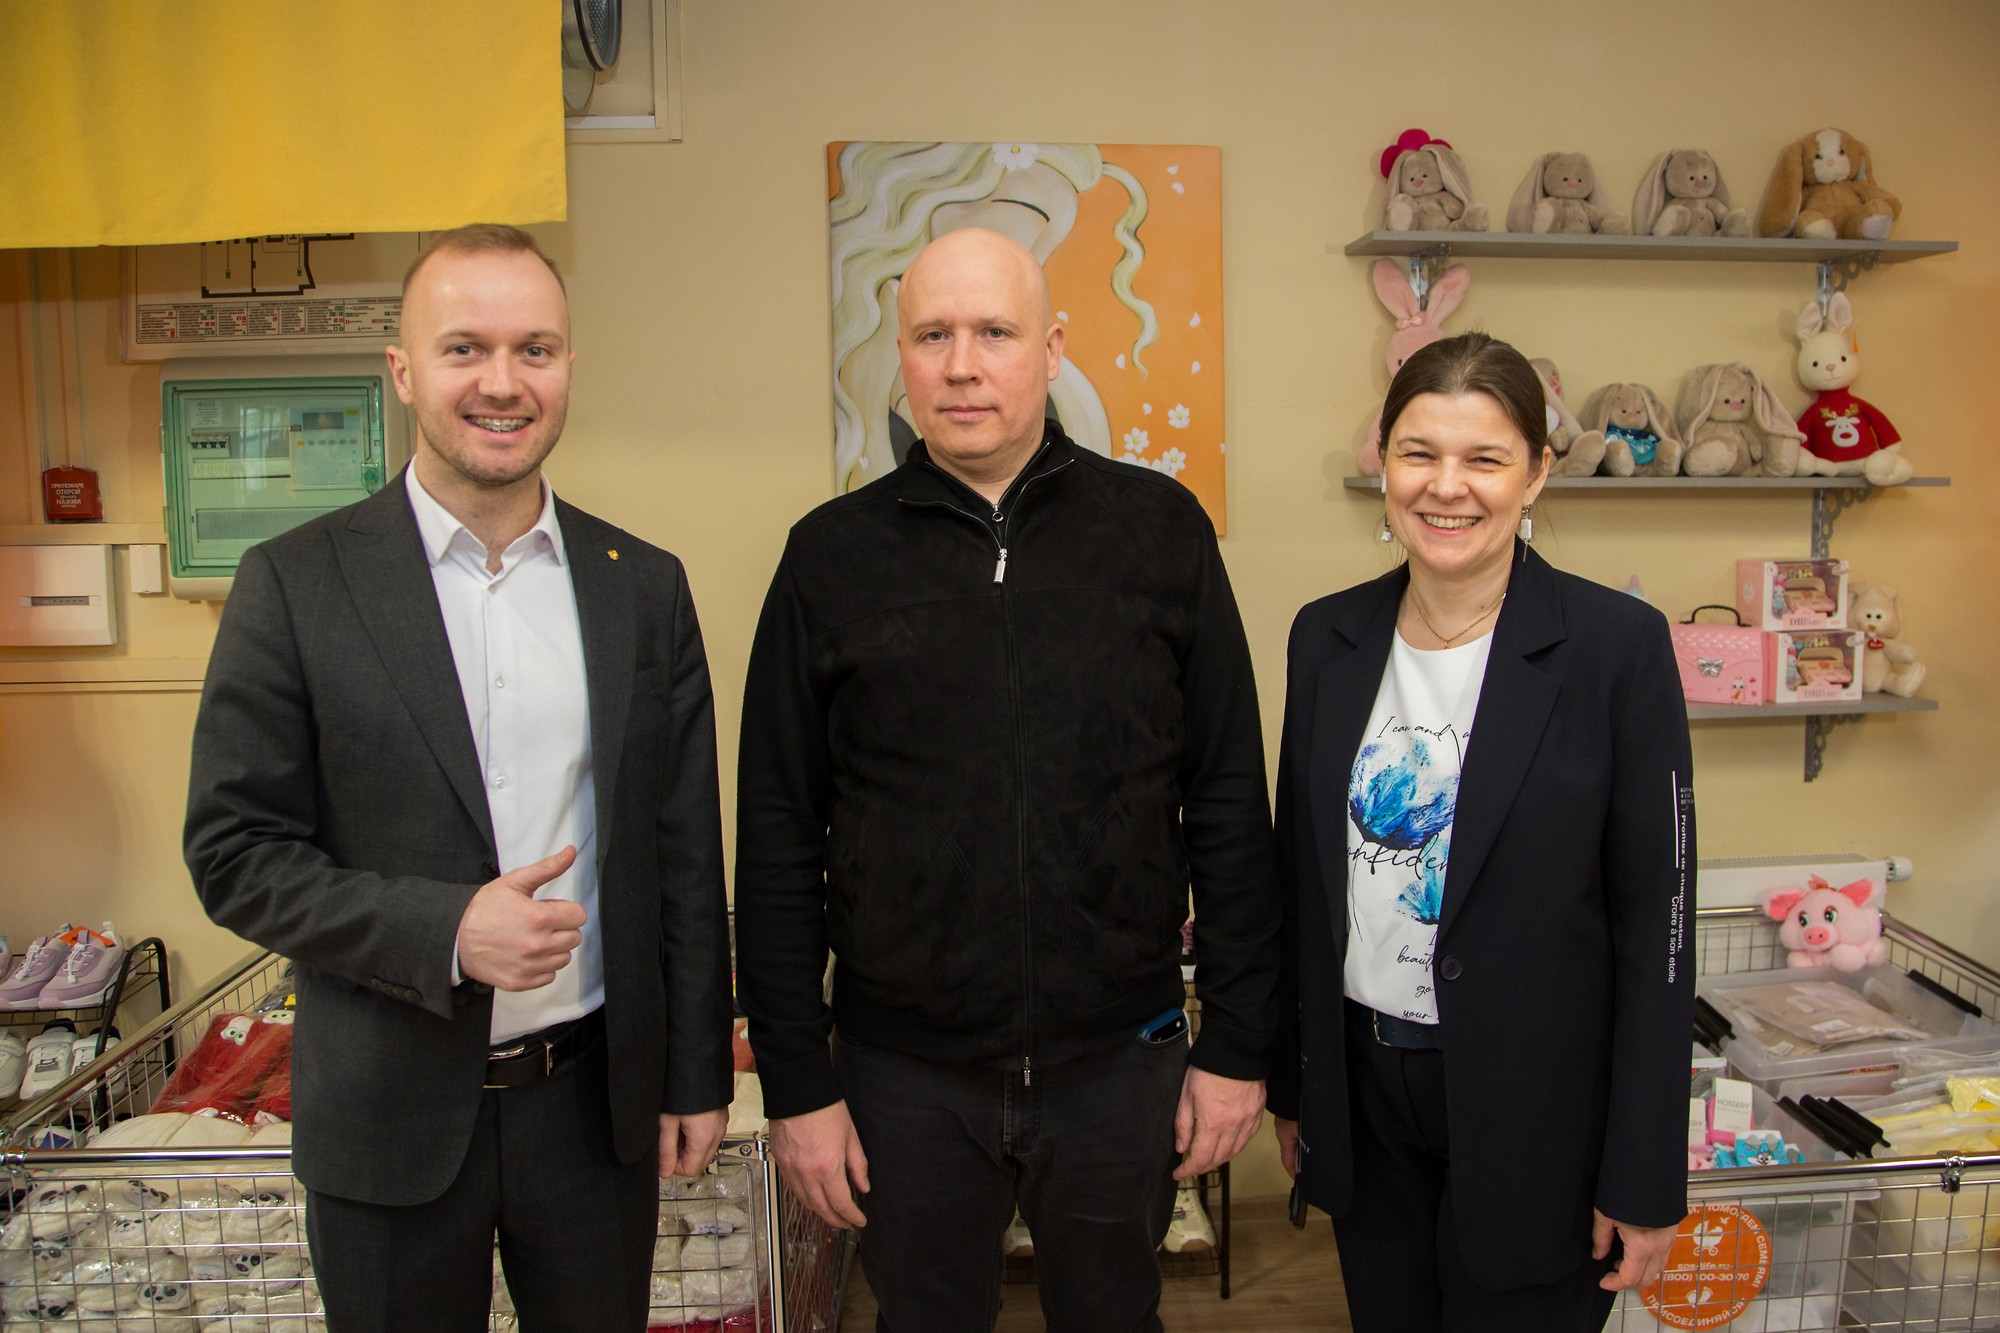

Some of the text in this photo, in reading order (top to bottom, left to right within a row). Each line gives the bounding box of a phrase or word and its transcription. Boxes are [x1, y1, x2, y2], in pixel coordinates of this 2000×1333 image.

[1414, 723, 1452, 742] and
[1671, 896, 1680, 926] Croire
[1669, 937, 1677, 955] son
[1402, 1009, 1433, 1021] your
[1717, 1099, 1750, 1109] HOSIERY
[1663, 1273, 1692, 1281] (800)
